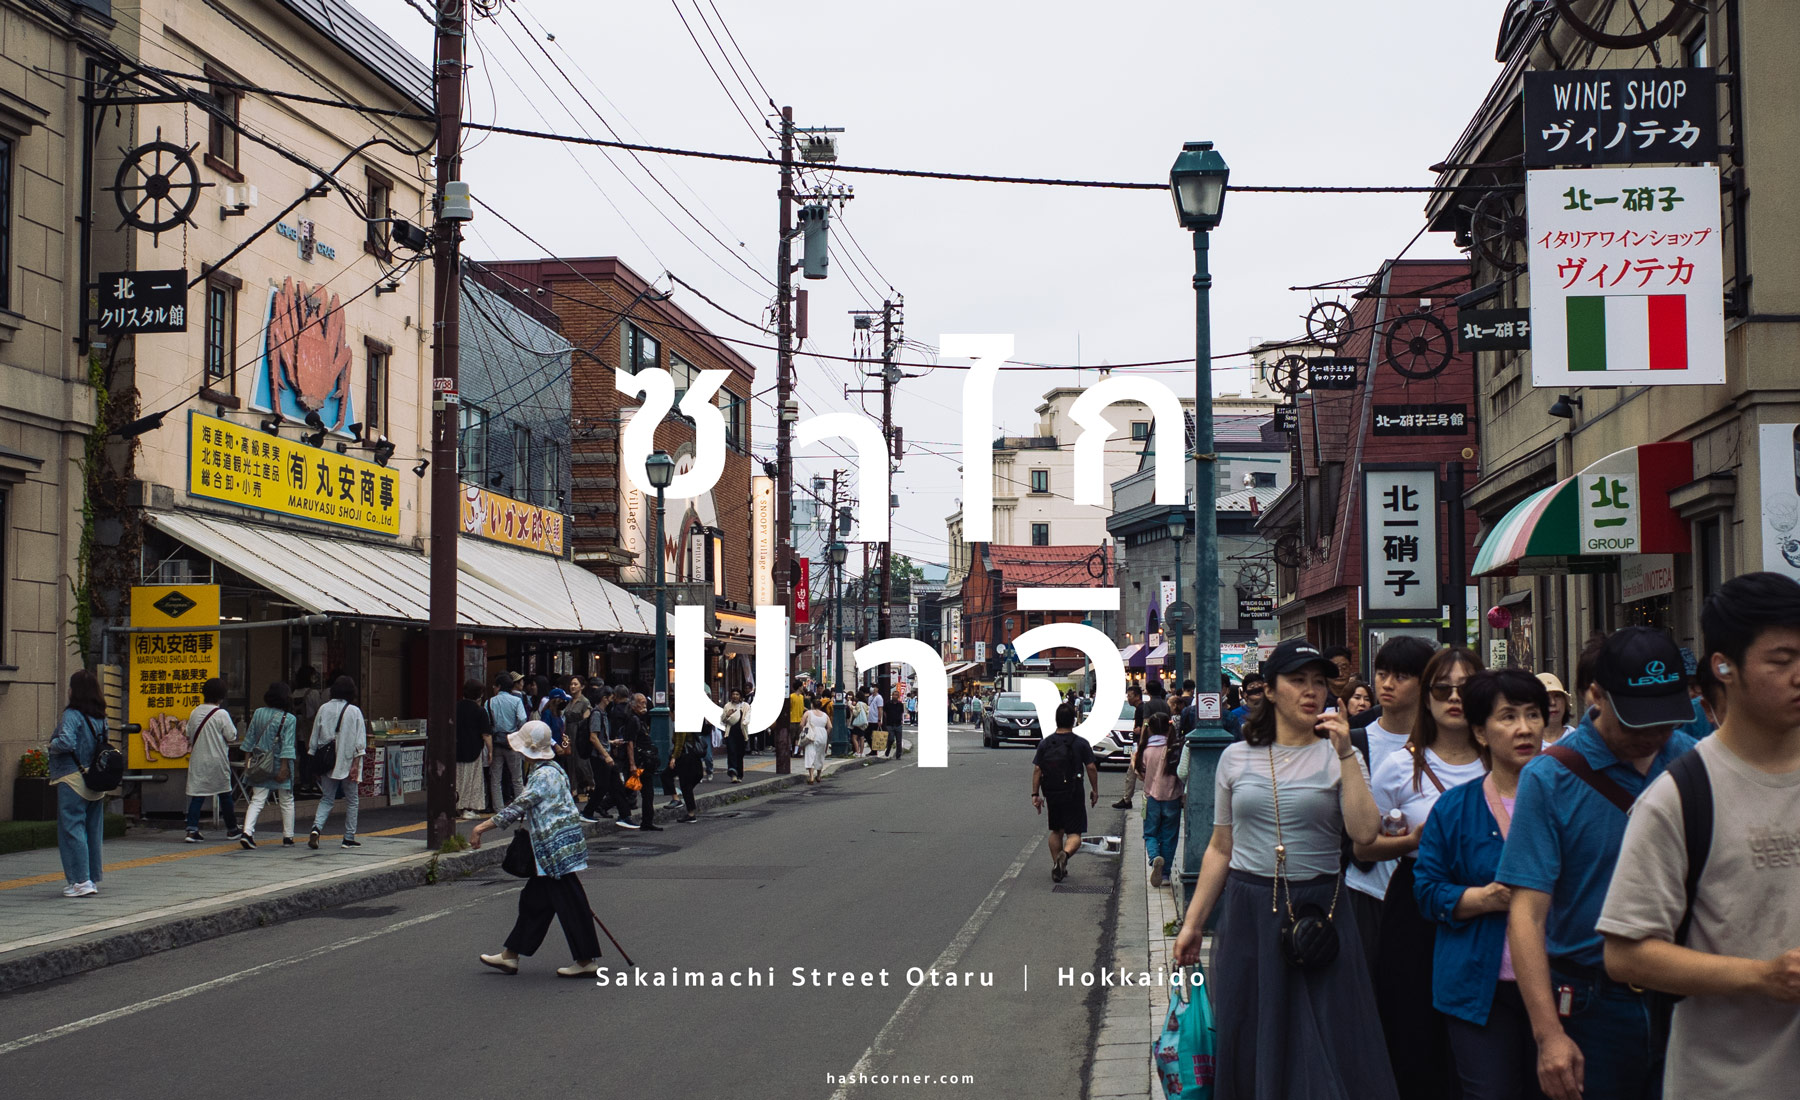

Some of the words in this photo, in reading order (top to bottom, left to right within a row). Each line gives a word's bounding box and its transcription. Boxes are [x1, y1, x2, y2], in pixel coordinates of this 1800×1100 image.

[1553, 81, 1612, 111] WINE
[1624, 80, 1687, 110] SHOP
[1541, 119, 1701, 152] ヴィノテカ
[1563, 186, 1685, 212] 北一硝子
[1537, 227, 1712, 249] イタリアワインショップ
[1557, 256, 1695, 289] ヴィノテカ
[100, 305, 185, 329] クリスタル館
[1464, 321, 1531, 340] 北一硝子
[1376, 413, 1464, 427] 北一硝子三号館
[202, 425, 281, 462] 海産物・高級果実
[201, 447, 280, 482] 北海道観光土産品
[288, 495, 335, 516] MARUYASU
[338, 506, 362, 521] SHOJI
[627, 488, 639, 531] Village
[759, 538, 767, 570] Village
[1383, 485, 1420, 597] 北一硝子
[1588, 538, 1634, 549] GROUP
[137, 655, 168, 664] MARUYASU
[169, 655, 187, 664] SHOJI
[1628, 672, 1680, 687] LEXUS
